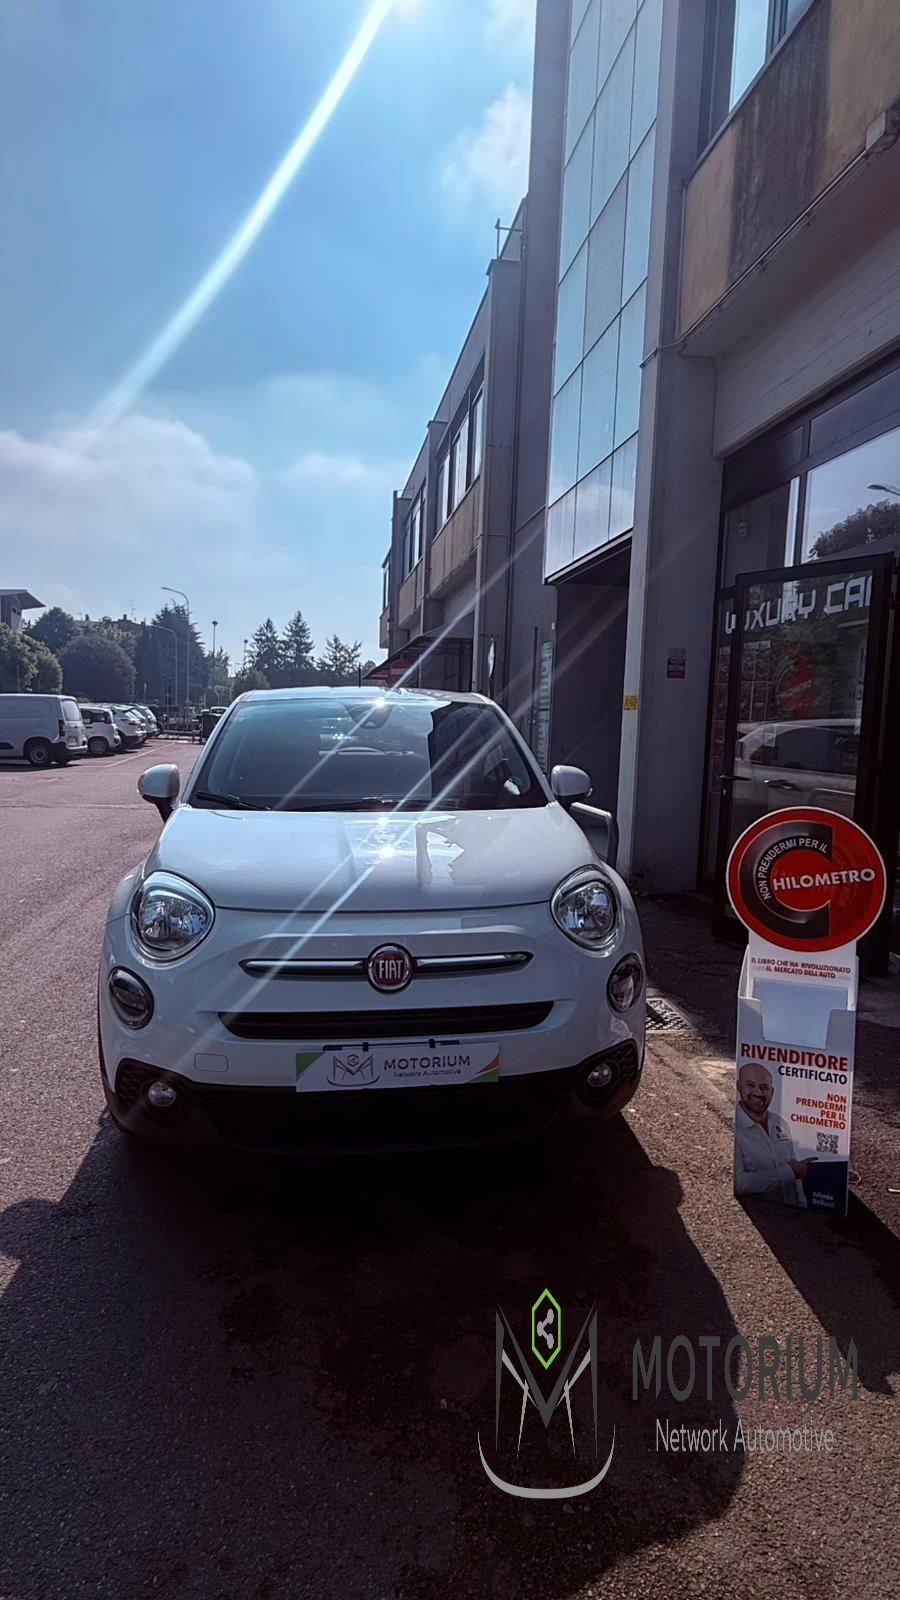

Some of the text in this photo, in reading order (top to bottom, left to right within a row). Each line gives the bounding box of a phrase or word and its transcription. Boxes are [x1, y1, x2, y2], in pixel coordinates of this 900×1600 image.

[757, 838, 828, 900] NON PRENDERMI PER IL
[378, 959, 404, 980] FIAT
[758, 958, 776, 966] LIBRO
[801, 962, 852, 974] RIVOLUZIONATO
[774, 966, 803, 975] MERCATO
[384, 1055, 471, 1070] MOTORIUM
[740, 1042, 848, 1073] RIVENDITORE
[777, 1064, 848, 1085] CERTIFICATO
[795, 1096, 847, 1113] PRENDERMI
[826, 1092, 847, 1104] NON
[790, 1113, 846, 1130] CHILOMETRO
[820, 1109, 847, 1122] PER IL
